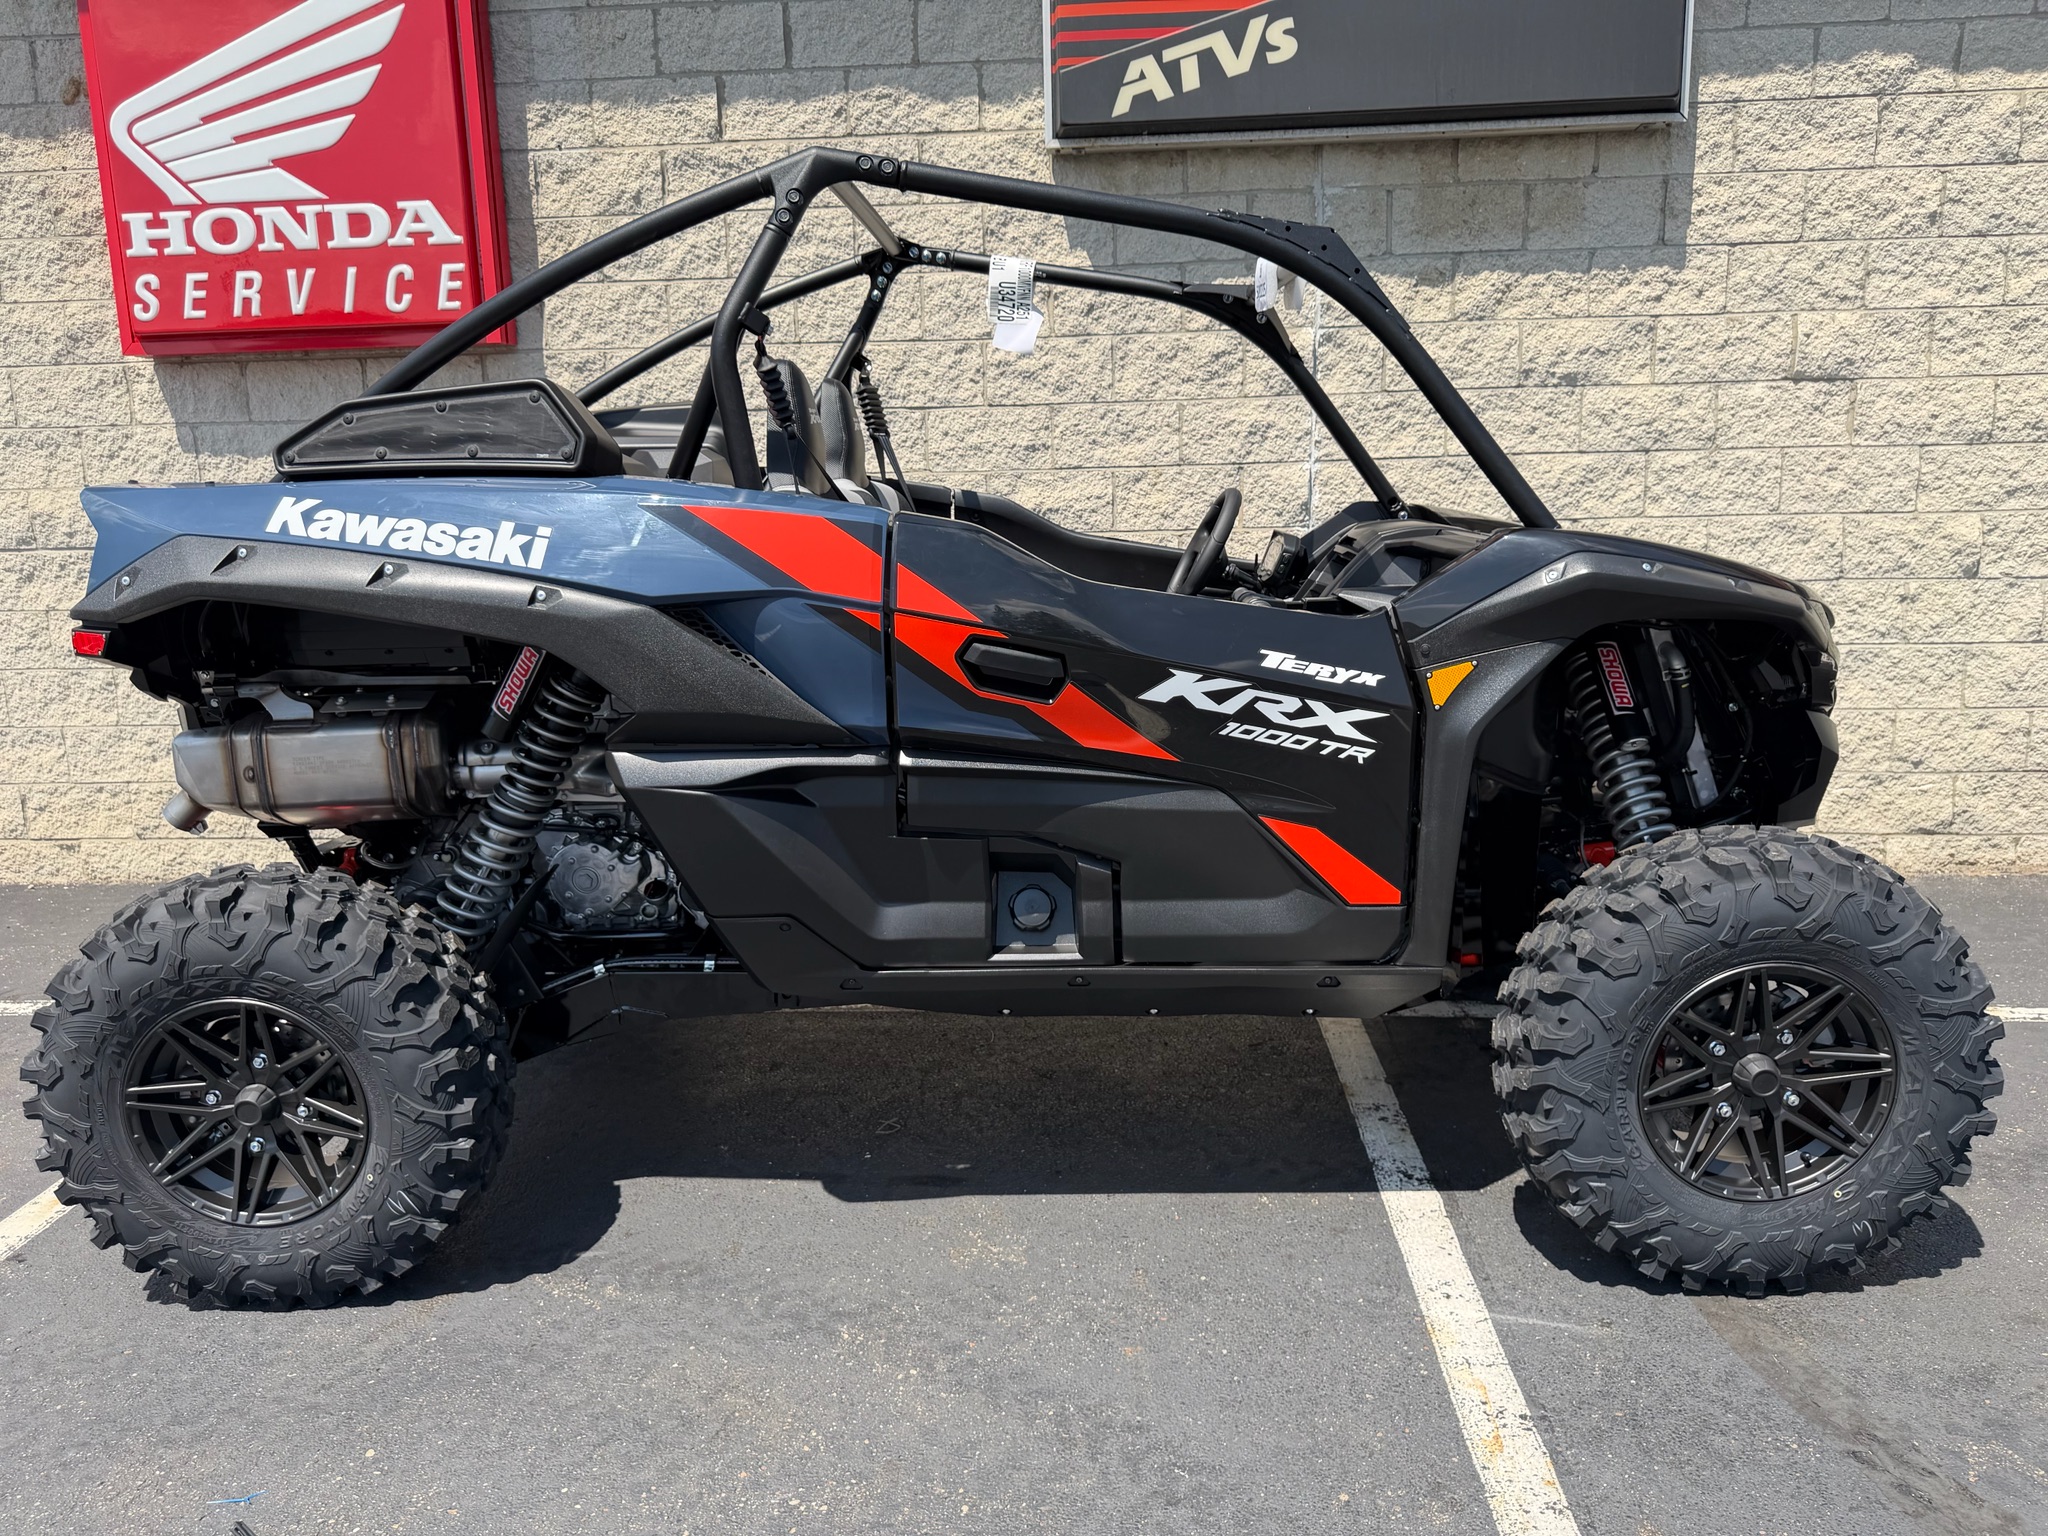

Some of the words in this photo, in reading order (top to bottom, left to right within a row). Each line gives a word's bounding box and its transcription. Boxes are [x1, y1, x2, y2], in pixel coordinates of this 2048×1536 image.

[1111, 13, 1298, 118] ATVs
[121, 199, 464, 258] HONDA
[133, 262, 466, 322] SERVICE
[998, 281, 1016, 322] U34720
[265, 496, 553, 570] Kawasaki
[498, 646, 539, 715] SHOWA
[1259, 649, 1386, 687] TERYX
[1599, 647, 1634, 707] SHOWA
[1138, 668, 1390, 744] KRX
[1614, 1016, 1650, 1161] CARNIVORE
[280, 1162, 384, 1250] CARNIVORE
